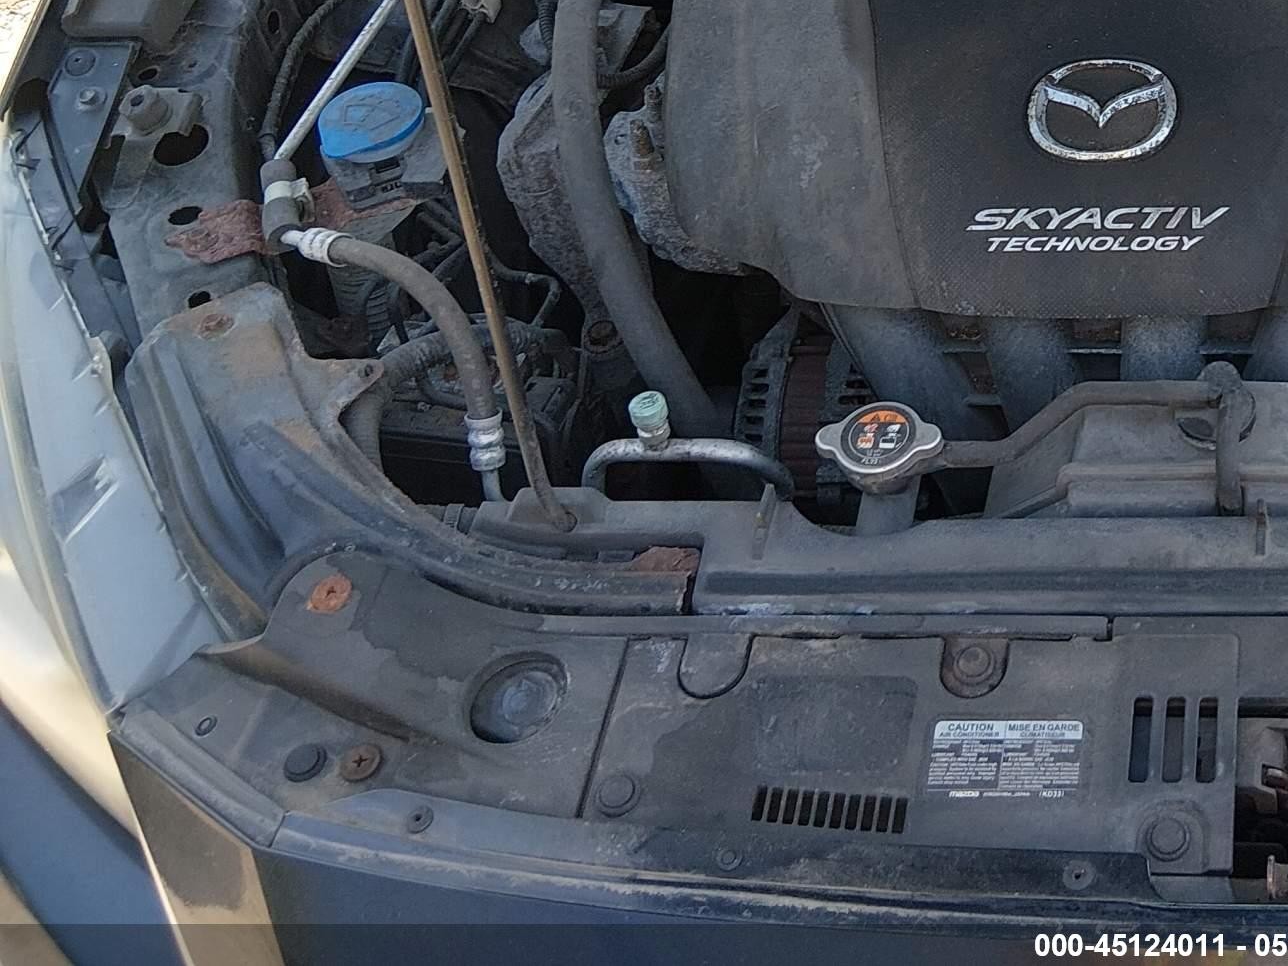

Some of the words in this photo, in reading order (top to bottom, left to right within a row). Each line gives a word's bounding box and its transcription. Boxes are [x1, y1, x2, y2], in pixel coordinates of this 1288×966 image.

[966, 206, 1231, 231] SKYACTIV
[987, 236, 1205, 252] TECHNOLOGY
[948, 723, 994, 731] CAUTION
[1047, 724, 1080, 732] GARDE
